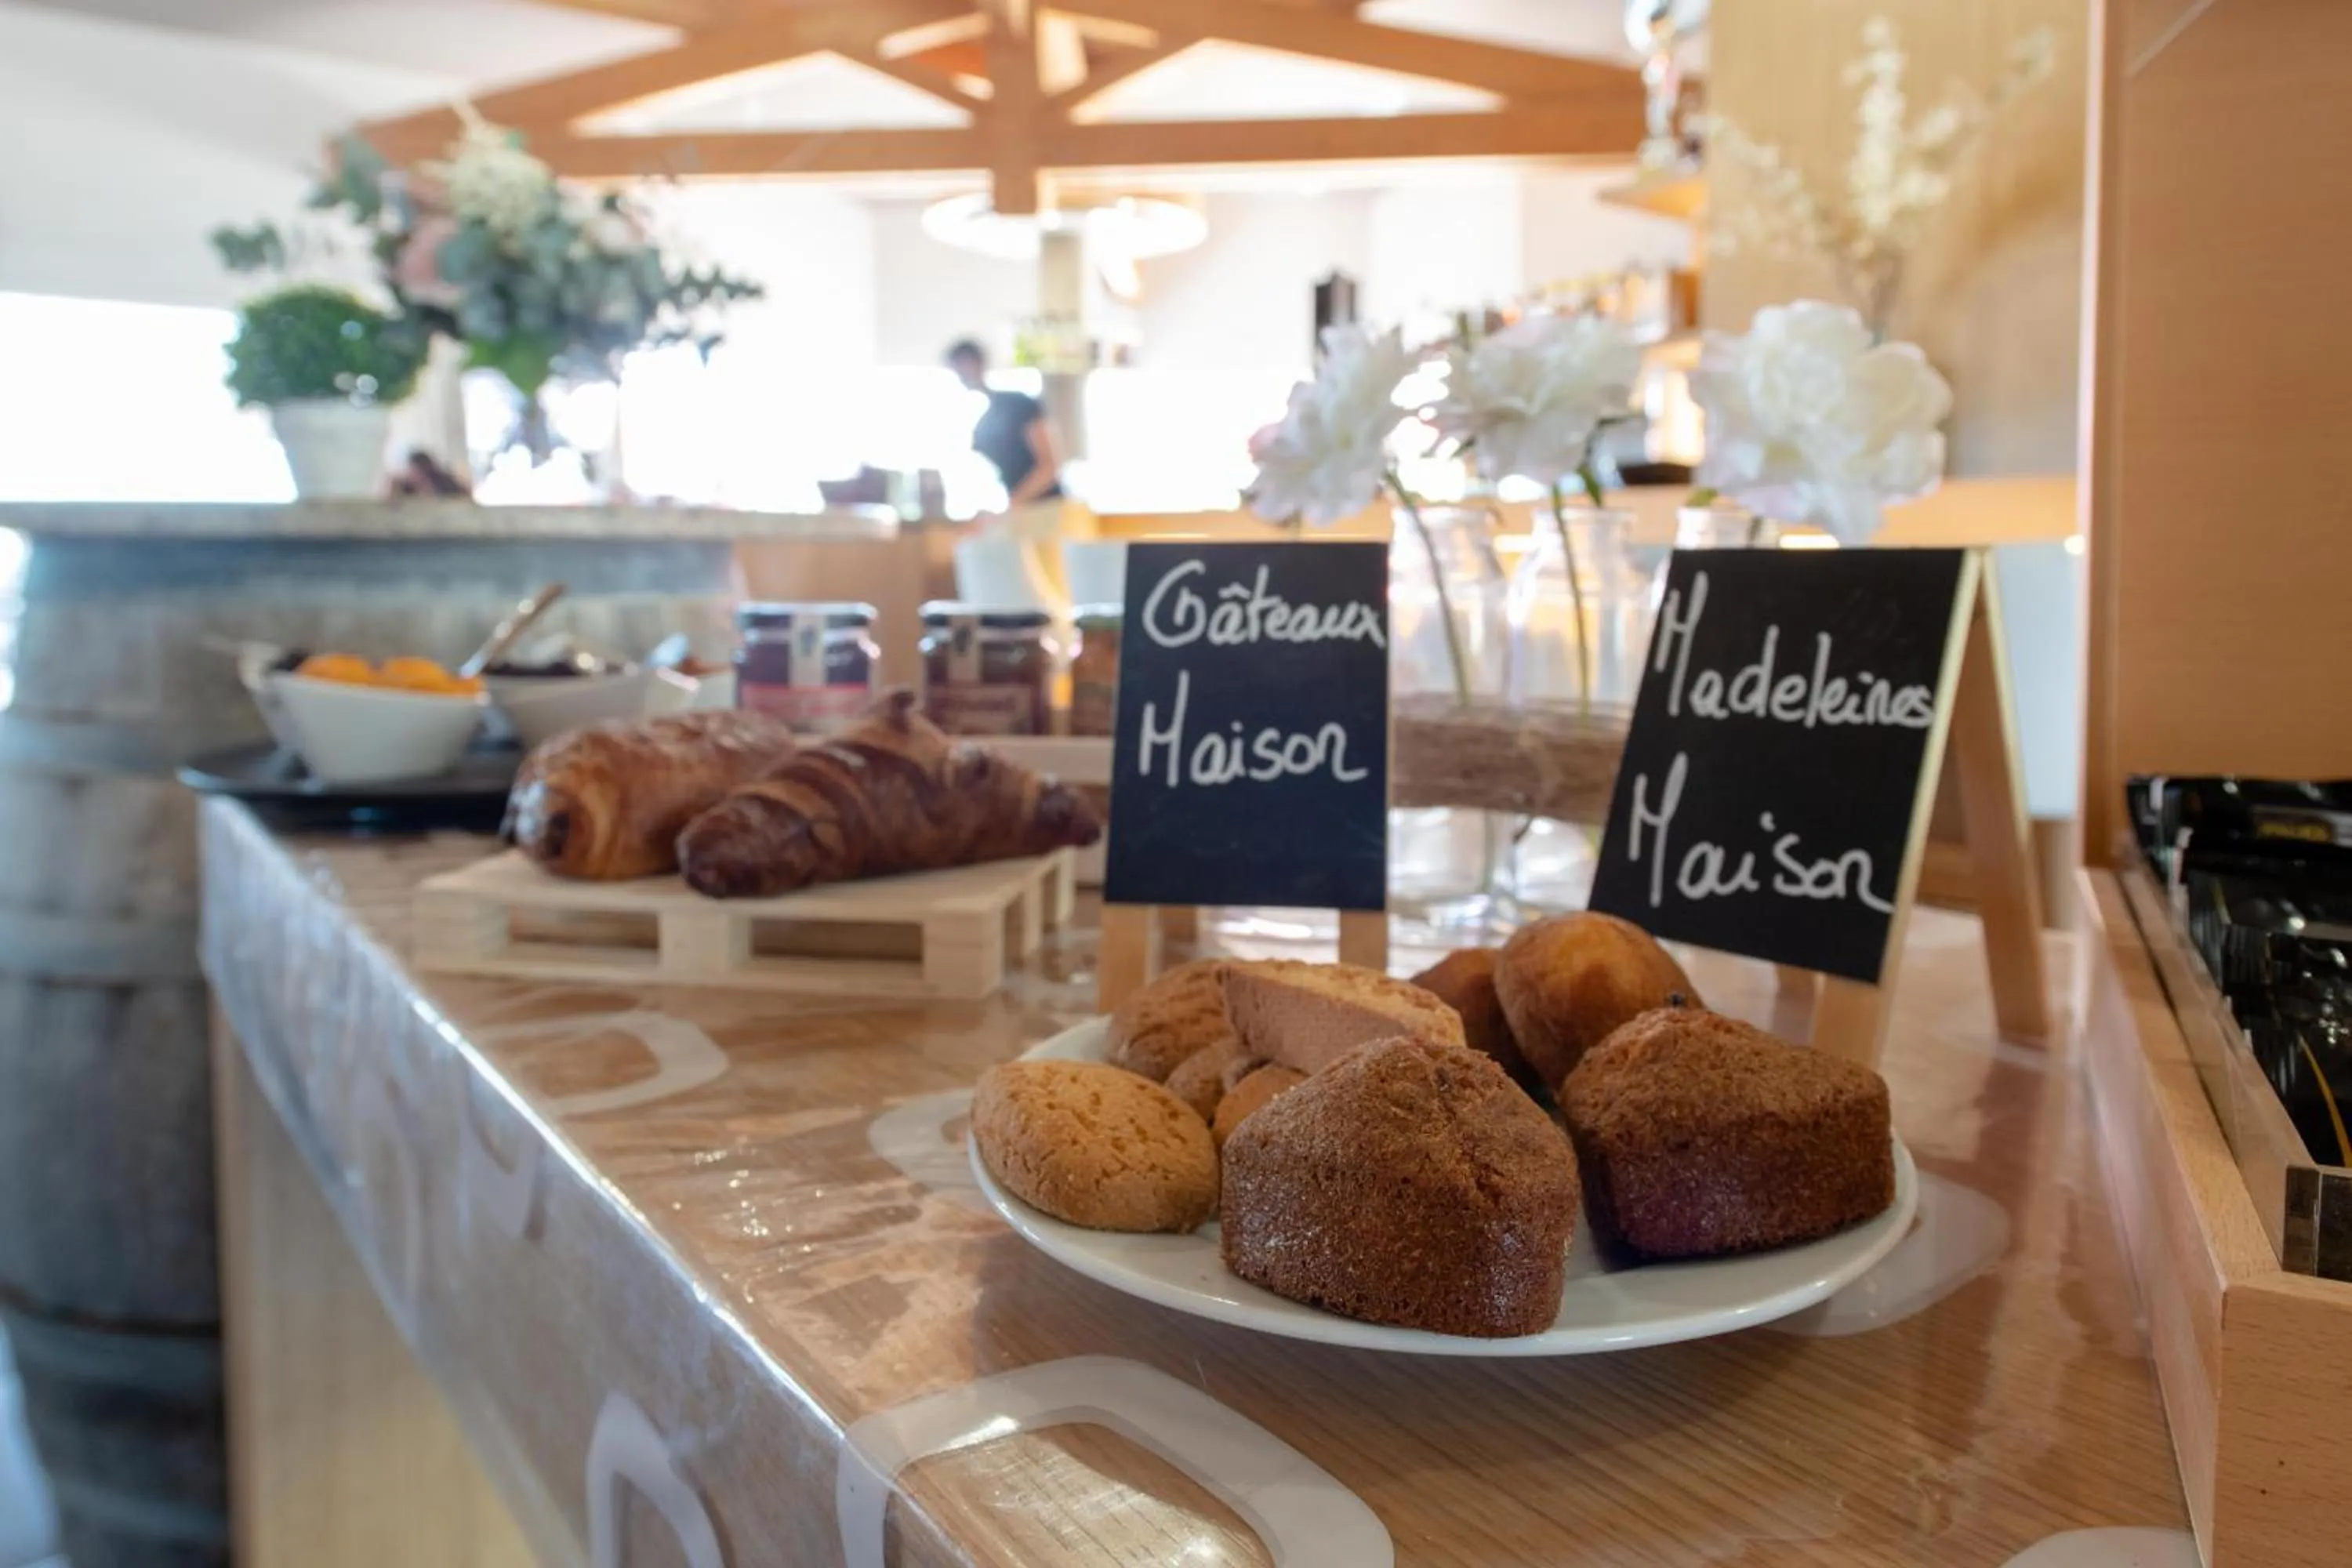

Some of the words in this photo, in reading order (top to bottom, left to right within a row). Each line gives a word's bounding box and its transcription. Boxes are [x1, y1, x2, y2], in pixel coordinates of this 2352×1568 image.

[1142, 559, 1385, 648] Gâteaux
[1654, 571, 1934, 729] Madeleines
[1139, 670, 1367, 787] Maison
[1628, 753, 1894, 913] Maison
